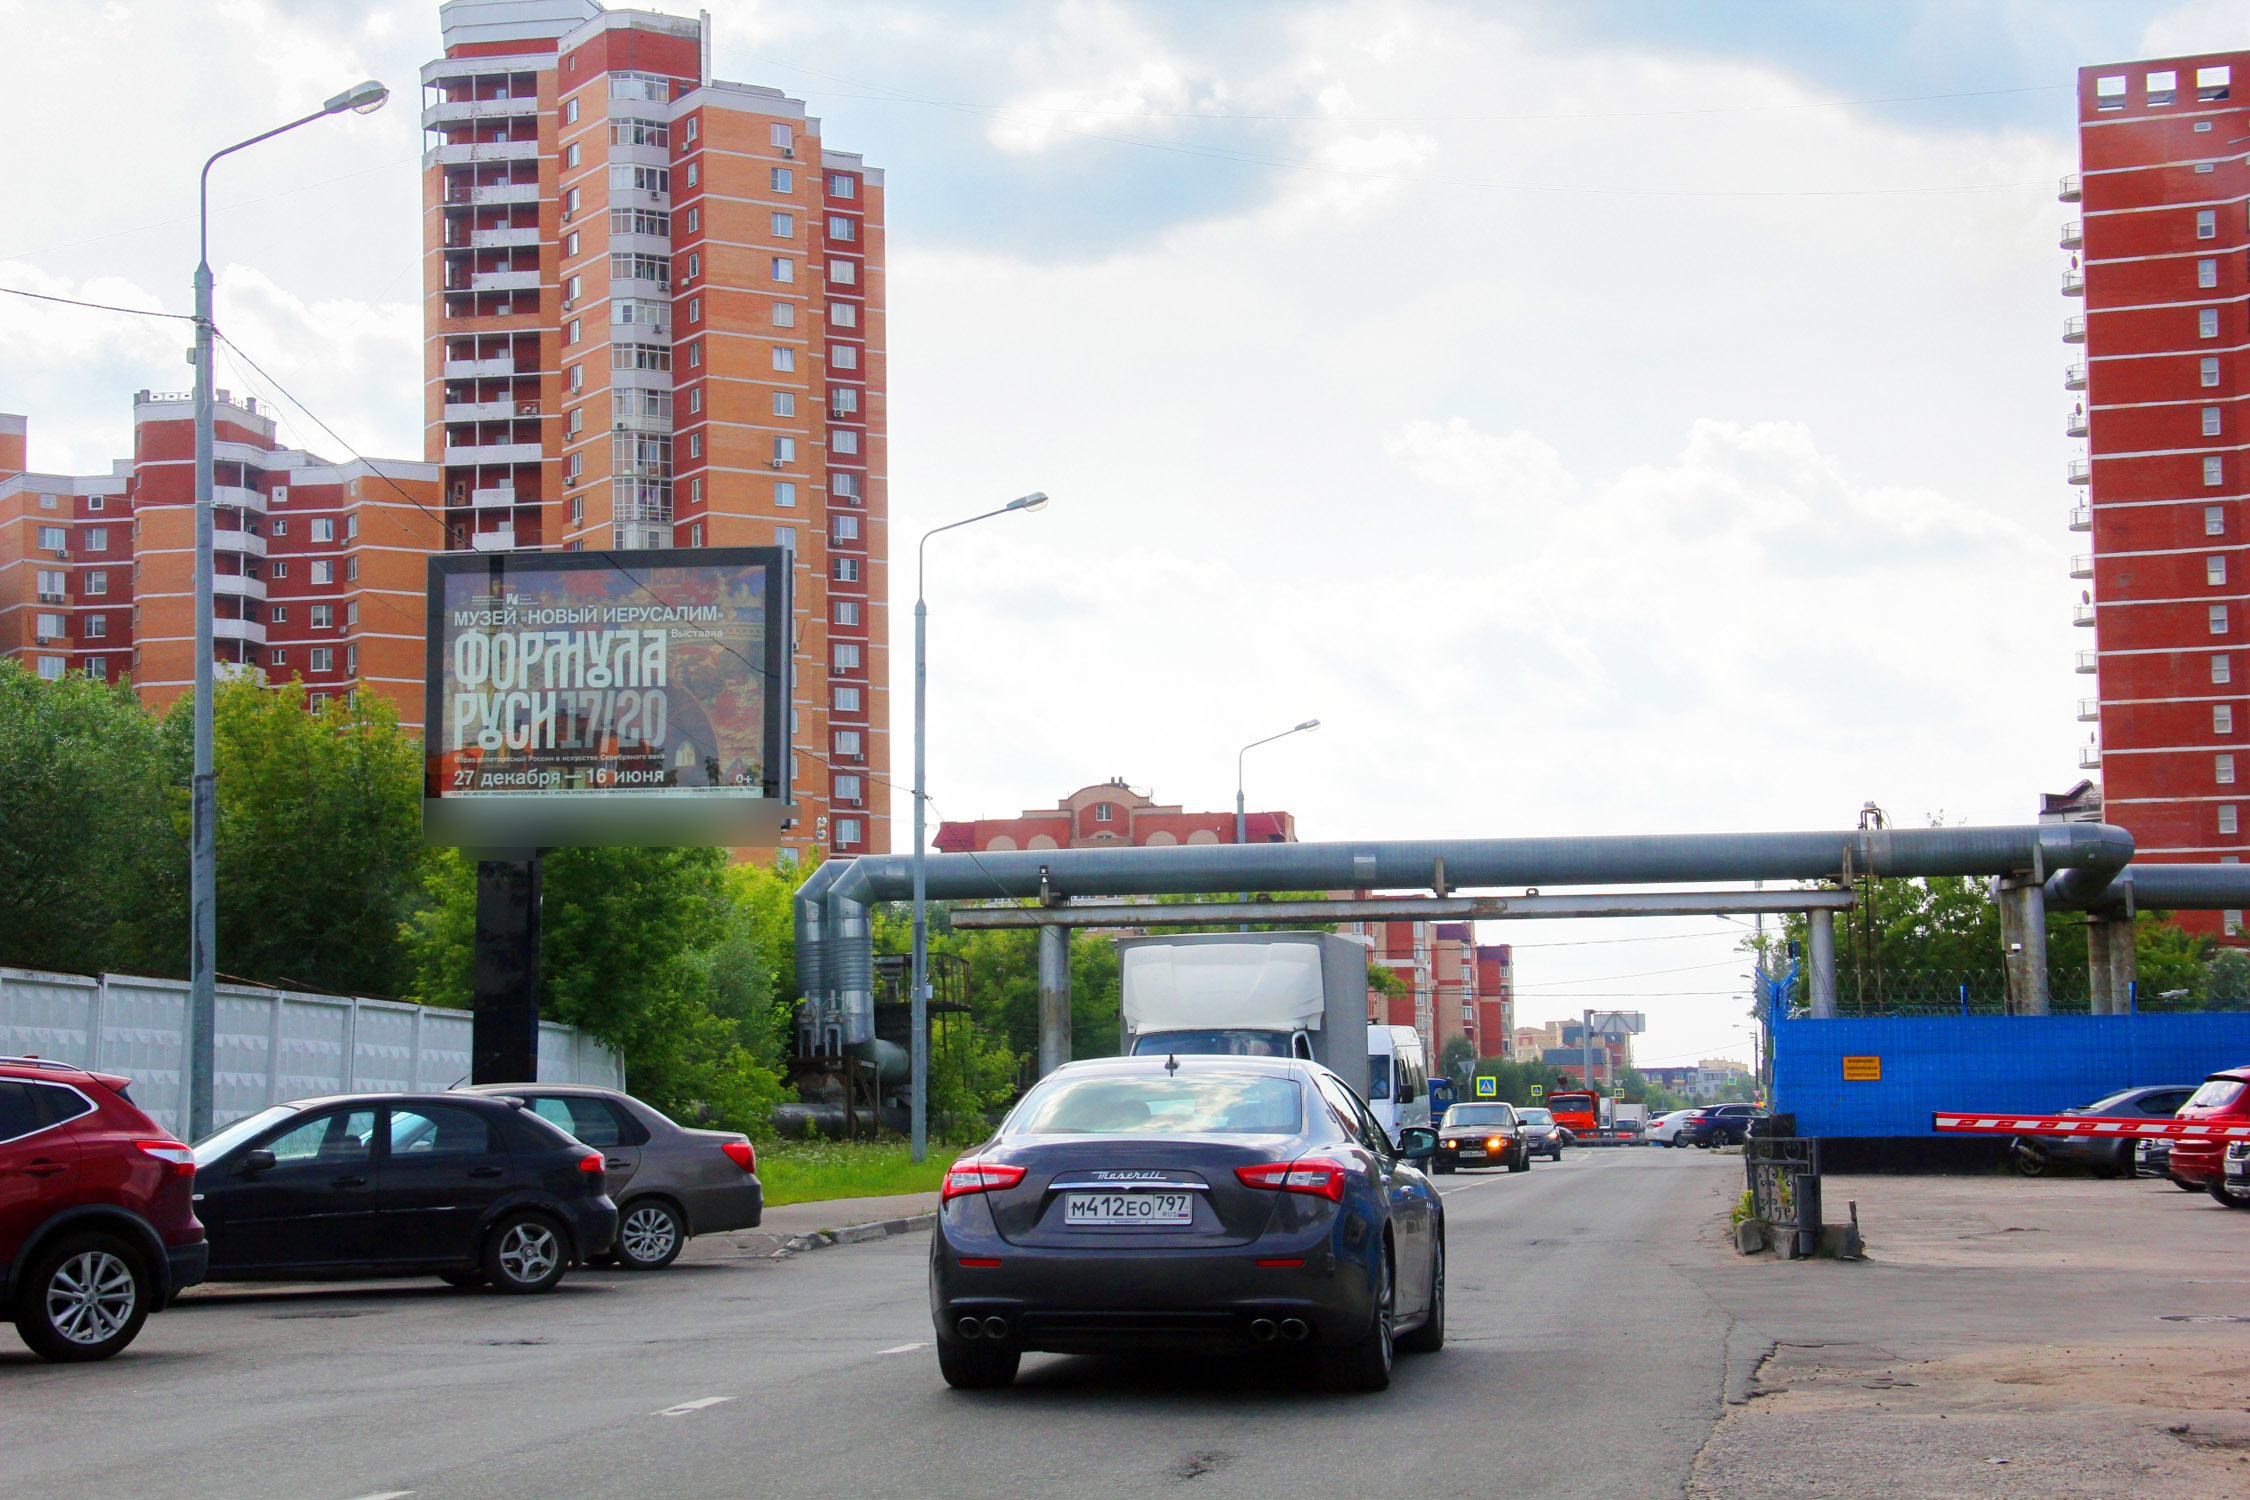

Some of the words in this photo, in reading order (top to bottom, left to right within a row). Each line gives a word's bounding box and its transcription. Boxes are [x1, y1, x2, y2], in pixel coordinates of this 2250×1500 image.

[454, 607, 517, 626] МУЗЕЙ
[521, 604, 598, 625] «НОВЫЙ
[603, 605, 724, 624] ИЕРУСАЛИМ»
[671, 629, 723, 639] Выставка
[454, 628, 667, 690] ФОРМУЛА
[454, 691, 556, 751] РУСИ
[600, 754, 647, 763] Серебряного
[454, 770, 475, 785] 27
[480, 767, 561, 788] декабря
[586, 768, 607, 783] 16
[614, 770, 665, 783] июня
[735, 774, 752, 784] 0+
[1091, 1171, 1167, 1180] Maserati
[1156, 1195, 1187, 1211] 797
